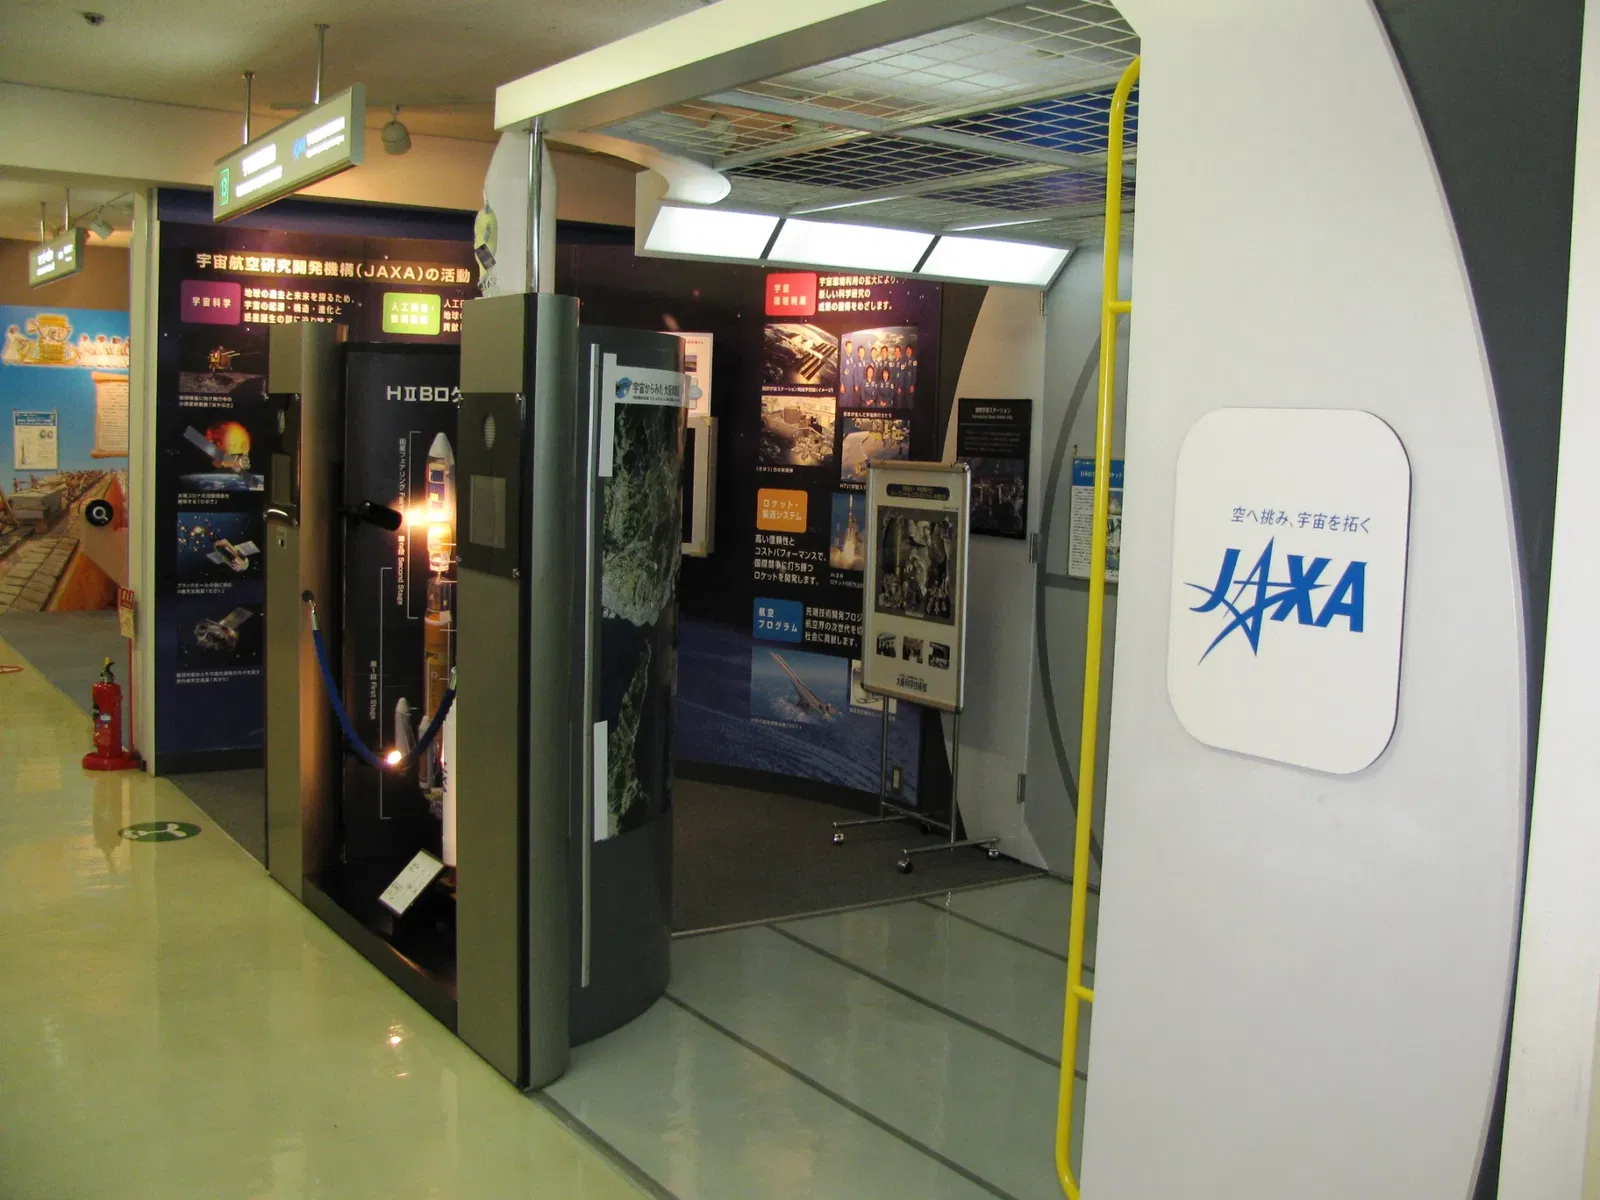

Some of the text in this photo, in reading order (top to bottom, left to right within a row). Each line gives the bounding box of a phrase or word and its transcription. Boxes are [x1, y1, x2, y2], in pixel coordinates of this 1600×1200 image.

[444, 299, 463, 309] 人工
[443, 311, 463, 320] 地球
[1230, 506, 1371, 534] 空へ挑み、宇宙を拓く
[755, 534, 795, 547] 高い信頼性と
[1183, 535, 1368, 666] JAXA
[758, 607, 775, 618] 航空
[758, 620, 798, 632] プログラム
